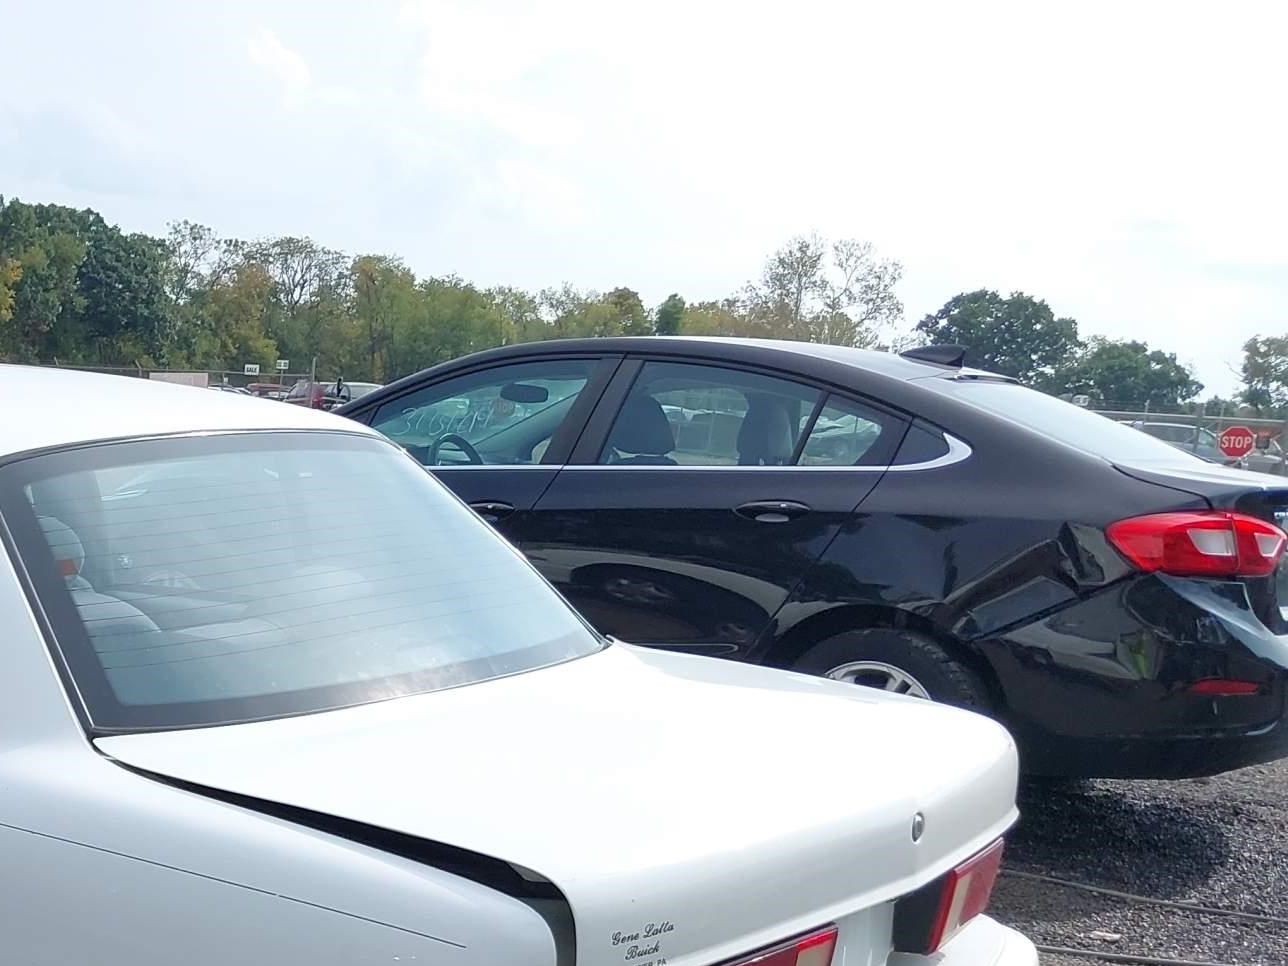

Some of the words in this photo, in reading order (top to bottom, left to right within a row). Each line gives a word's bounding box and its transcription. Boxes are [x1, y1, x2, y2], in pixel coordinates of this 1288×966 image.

[1221, 436, 1252, 448] STOP
[611, 931, 640, 946] Gene
[625, 940, 660, 961] Buick
[656, 958, 667, 966] PA
